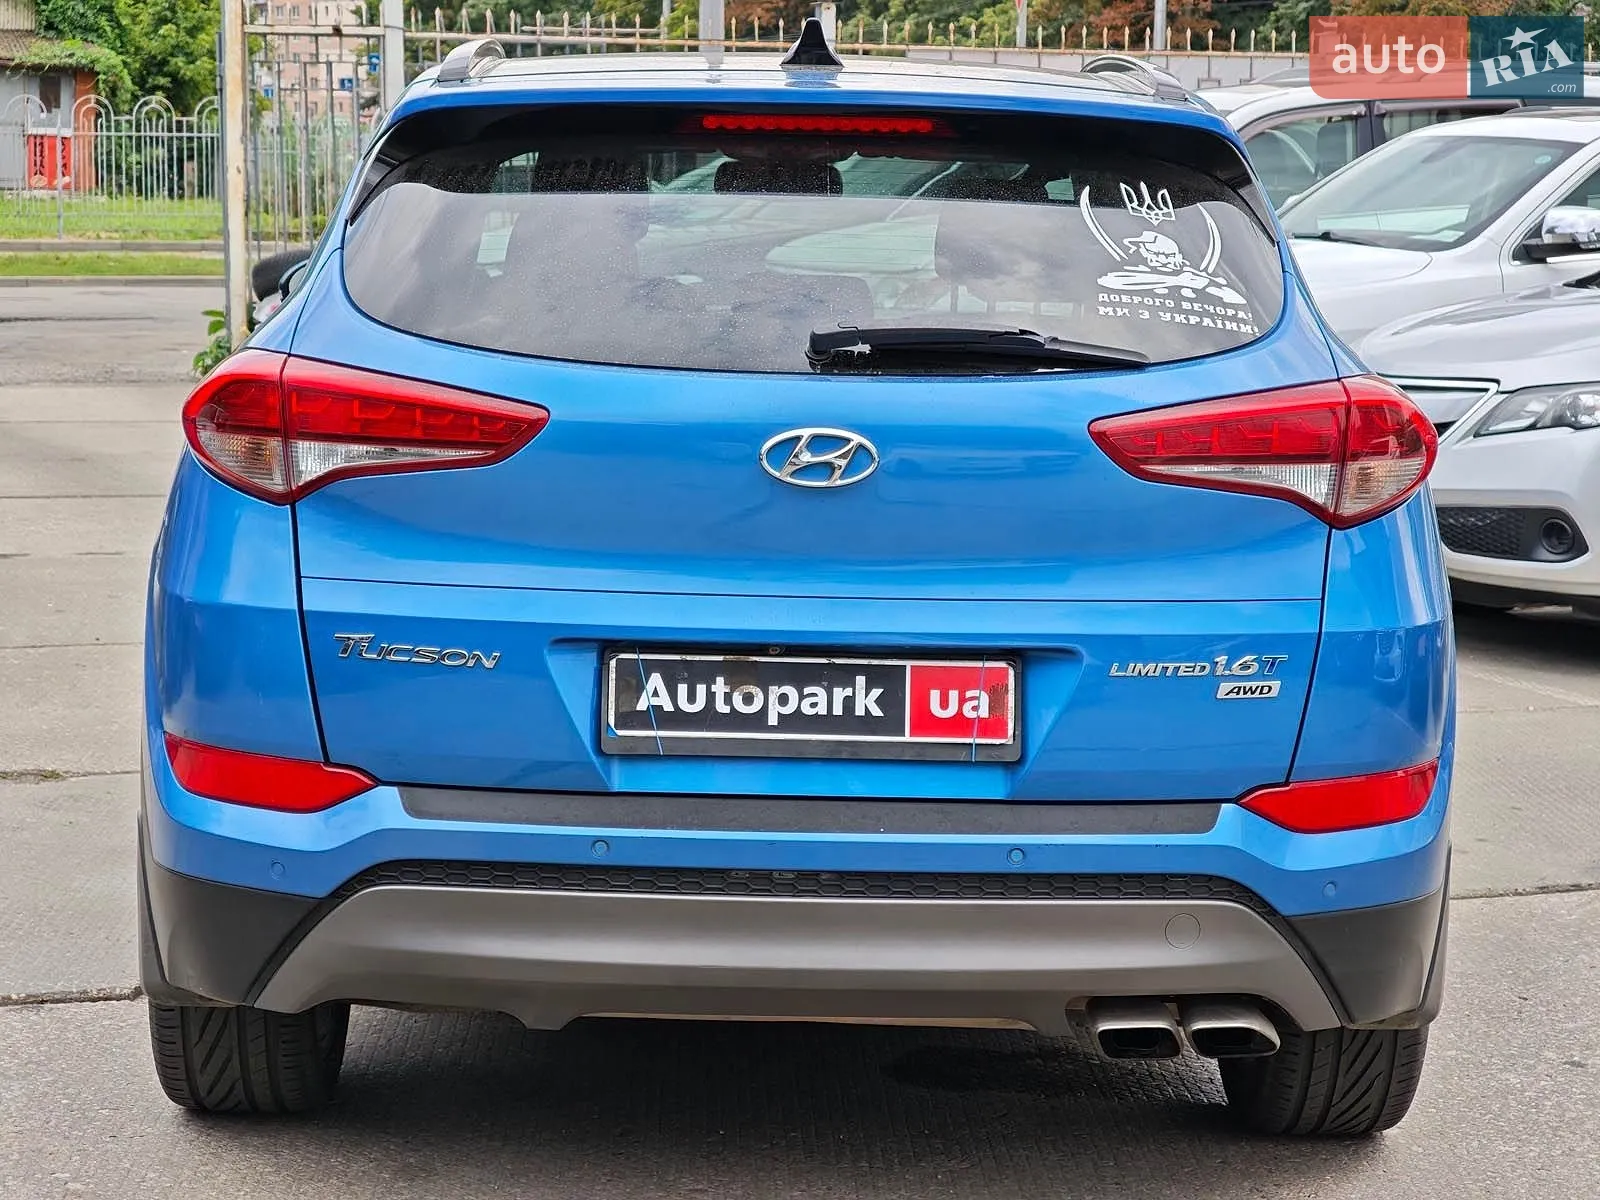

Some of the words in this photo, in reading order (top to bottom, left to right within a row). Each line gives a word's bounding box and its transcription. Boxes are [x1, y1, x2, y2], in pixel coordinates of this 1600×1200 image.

[1098, 293, 1175, 308] ДОБРОГО
[333, 633, 500, 669] TUCSON
[1108, 662, 1210, 678] LIMITED
[1223, 684, 1273, 697] AWD
[636, 672, 885, 726] Autopark
[928, 688, 990, 718] ua
